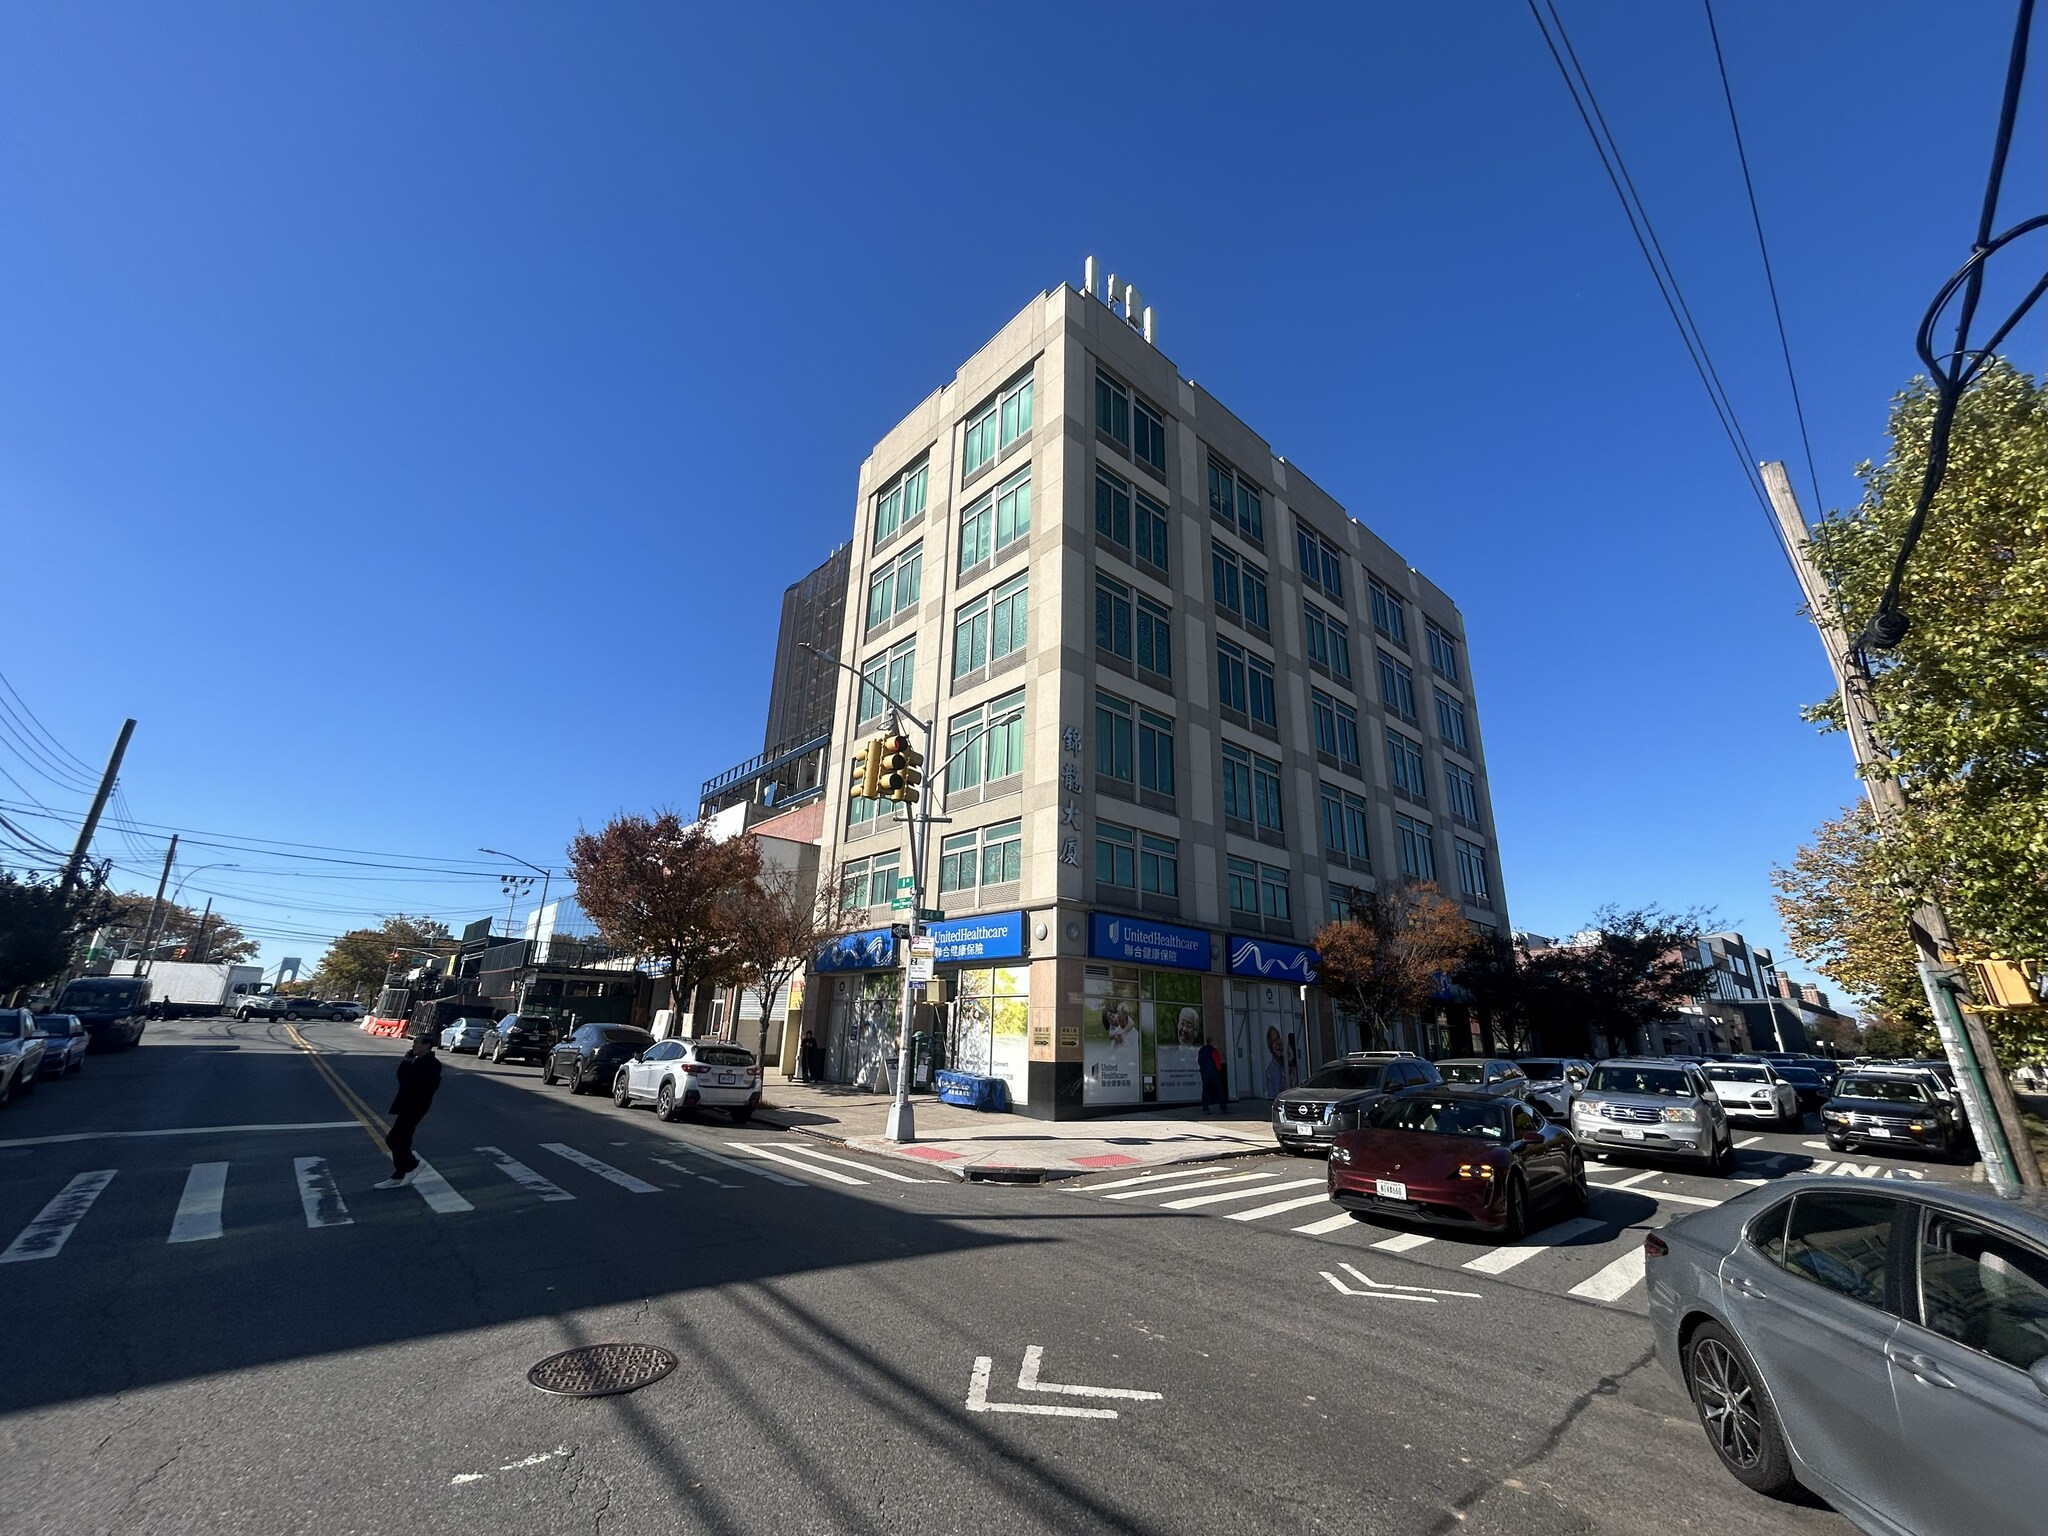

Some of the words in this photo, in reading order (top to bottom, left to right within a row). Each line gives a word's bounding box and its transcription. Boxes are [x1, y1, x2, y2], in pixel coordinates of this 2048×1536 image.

[934, 926, 1008, 944] UnitedHealthcare
[1124, 927, 1199, 951] UnitedHealthcare
[1124, 944, 1177, 962] 聯合健康保險
[1101, 1063, 1118, 1072] United
[1101, 1071, 1128, 1080] Healthcare
